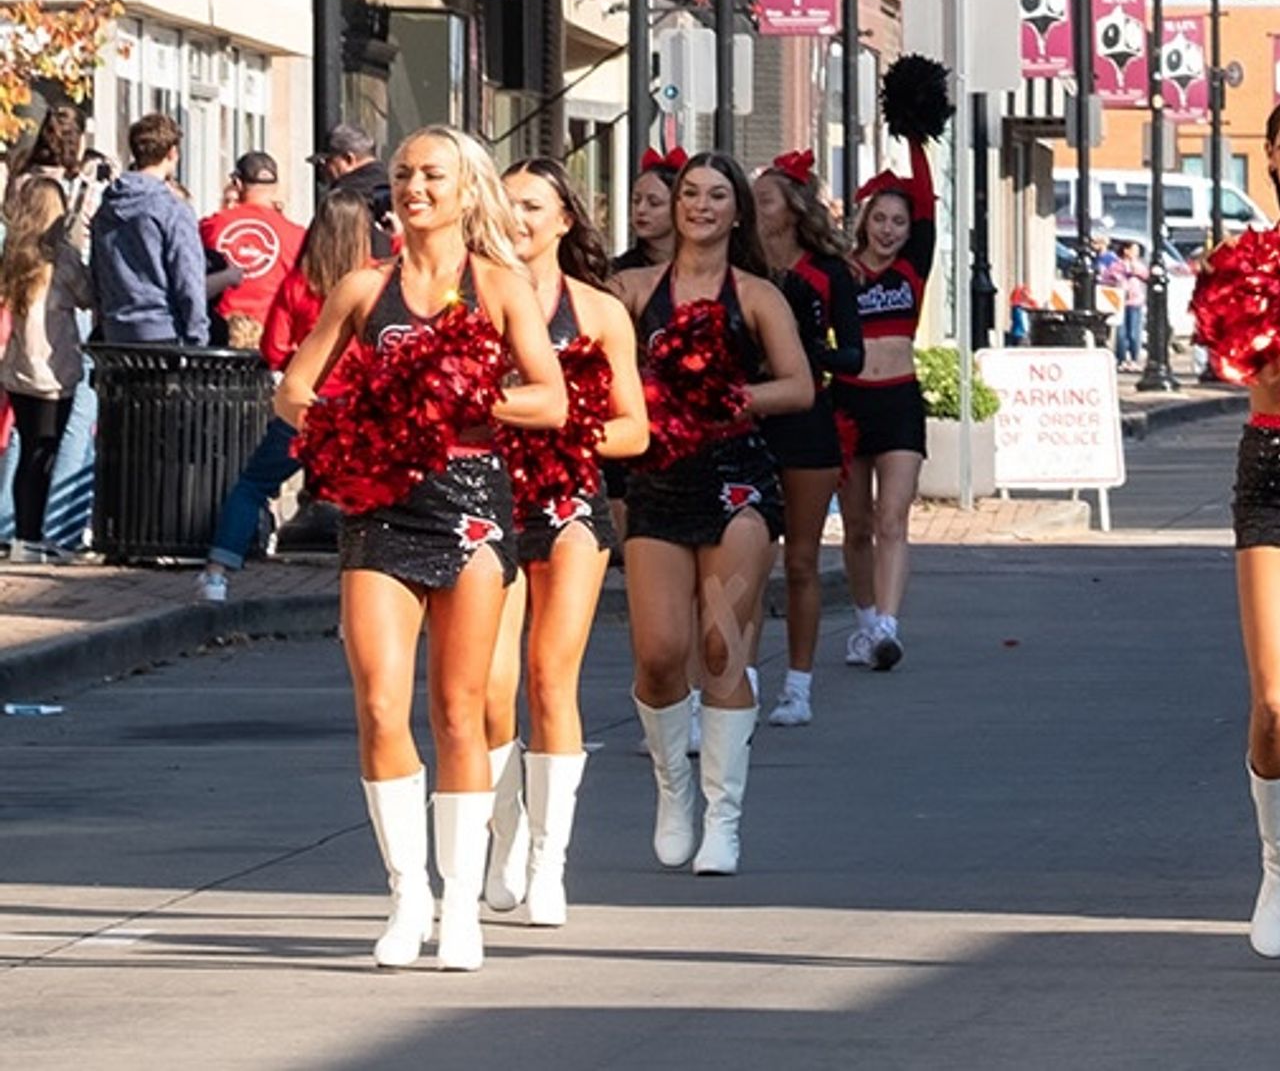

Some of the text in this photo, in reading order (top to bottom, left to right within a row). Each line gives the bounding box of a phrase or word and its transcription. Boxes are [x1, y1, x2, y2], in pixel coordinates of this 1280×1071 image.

[1028, 362, 1064, 382] NO
[995, 387, 1101, 407] PARKING
[999, 413, 1101, 428] BY ORDER
[1000, 431, 1102, 446] OF POLICE
